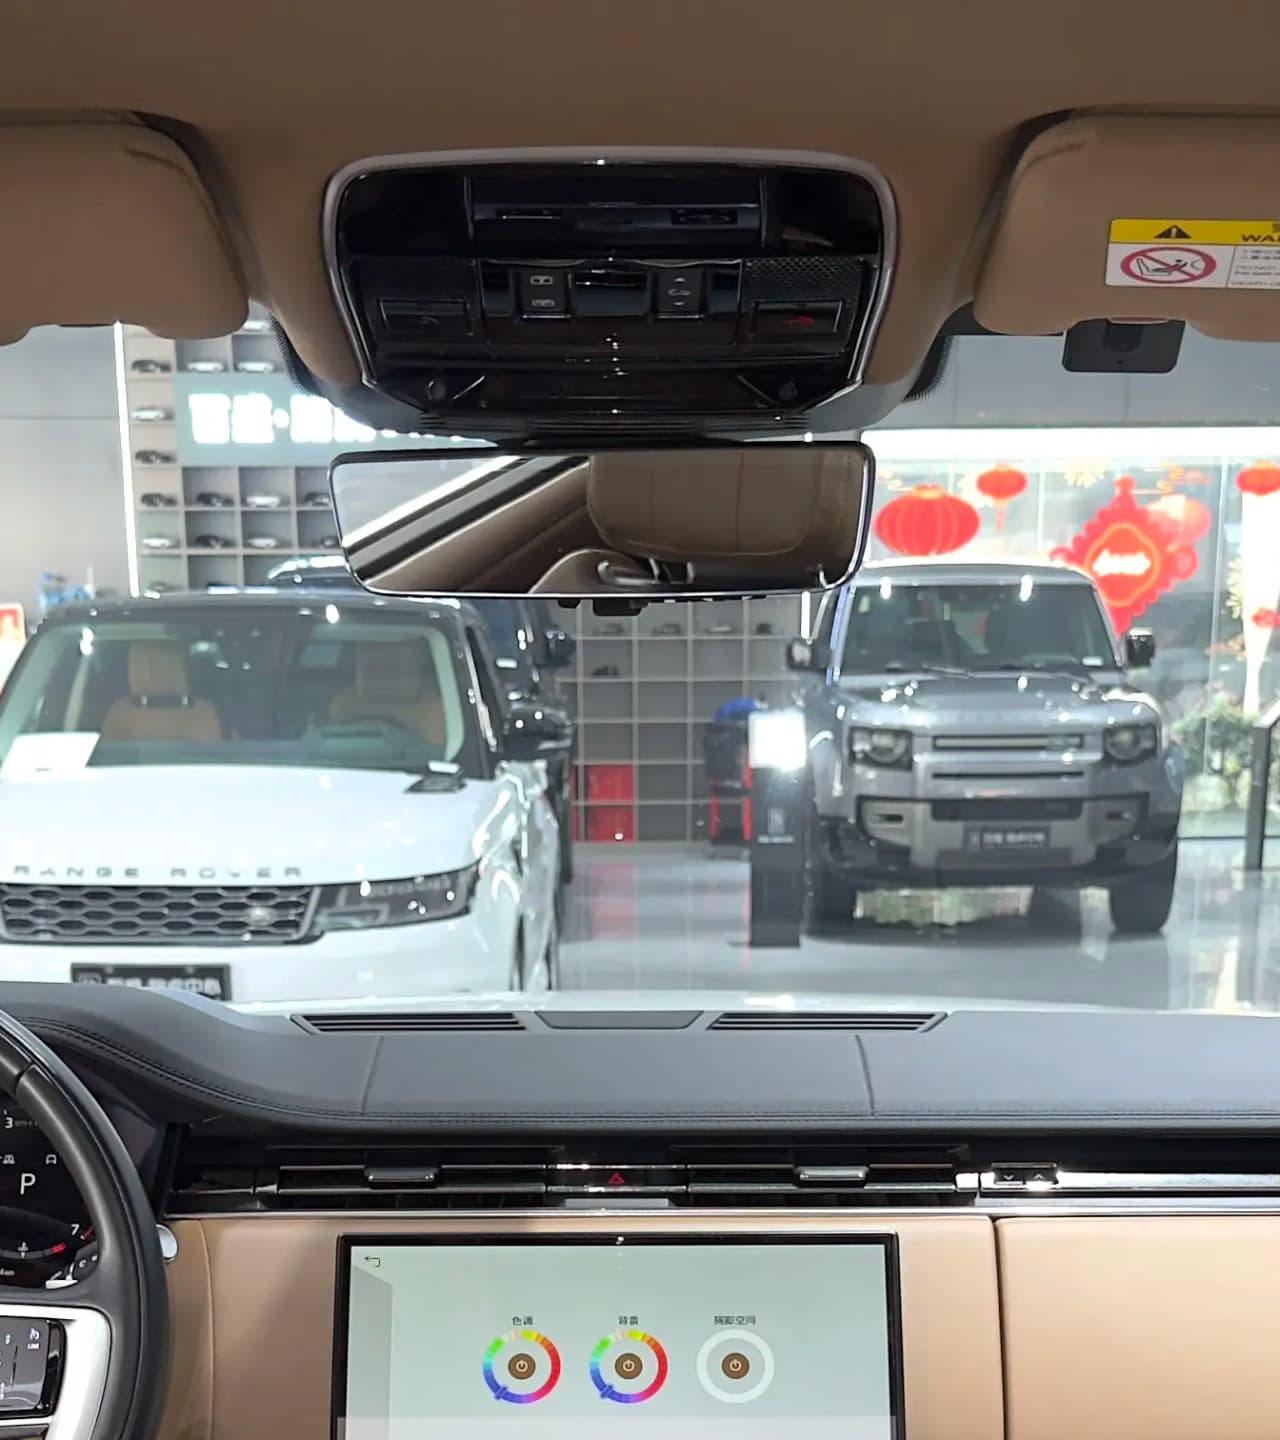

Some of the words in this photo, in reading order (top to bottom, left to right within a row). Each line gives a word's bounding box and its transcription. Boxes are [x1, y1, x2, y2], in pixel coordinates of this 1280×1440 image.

[14, 864, 139, 879] RANGE
[171, 866, 302, 879] ROVER
[5, 1117, 14, 1129] 3
[20, 1172, 36, 1195] P
[71, 1223, 80, 1236] 7
